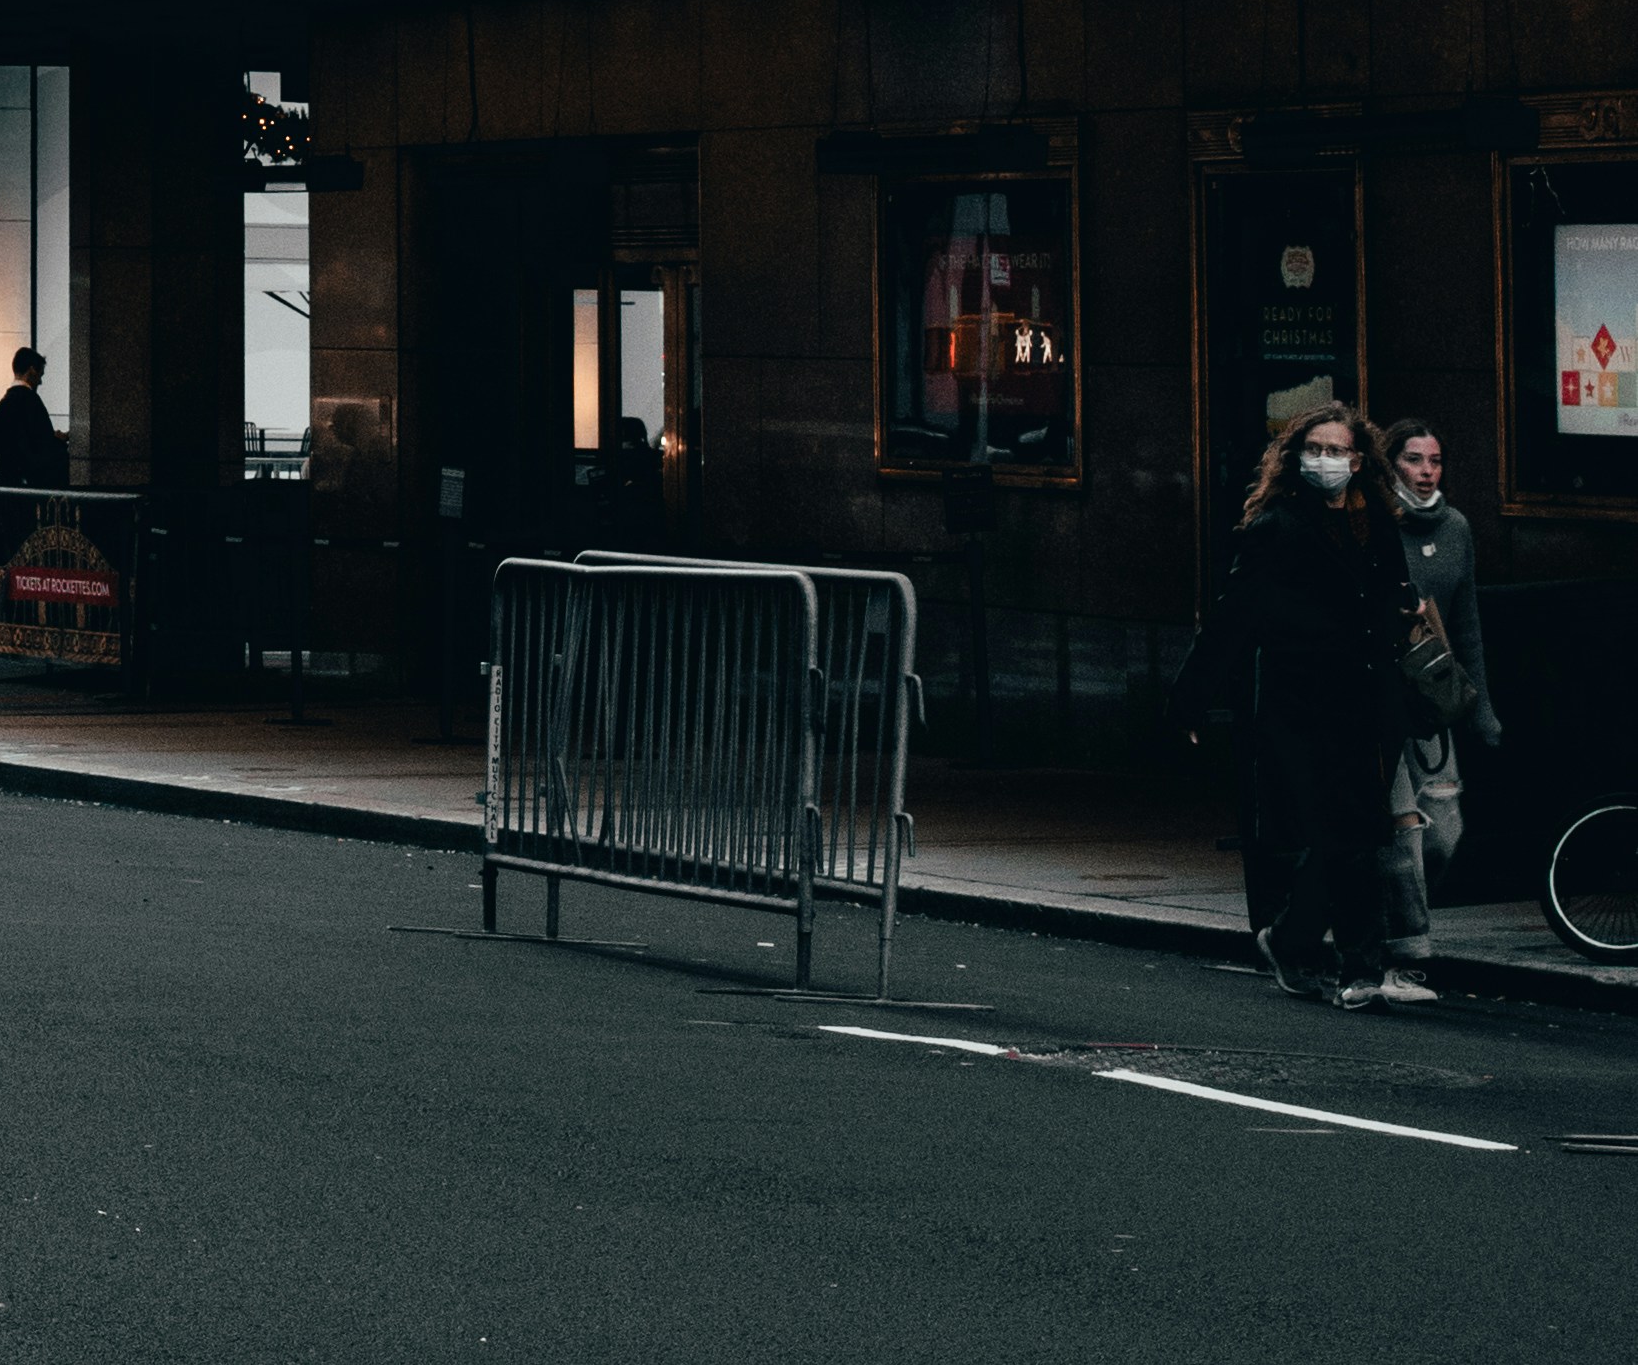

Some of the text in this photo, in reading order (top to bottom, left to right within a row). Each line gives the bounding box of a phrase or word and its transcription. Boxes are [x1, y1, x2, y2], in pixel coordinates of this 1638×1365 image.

[1263, 306, 1334, 322] READY FOR
[1263, 329, 1334, 345] CHRISTMAS
[15, 575, 42, 592] TICKETS
[52, 579, 110, 597] ROCKETTES.COM
[489, 804, 498, 840] HALL
